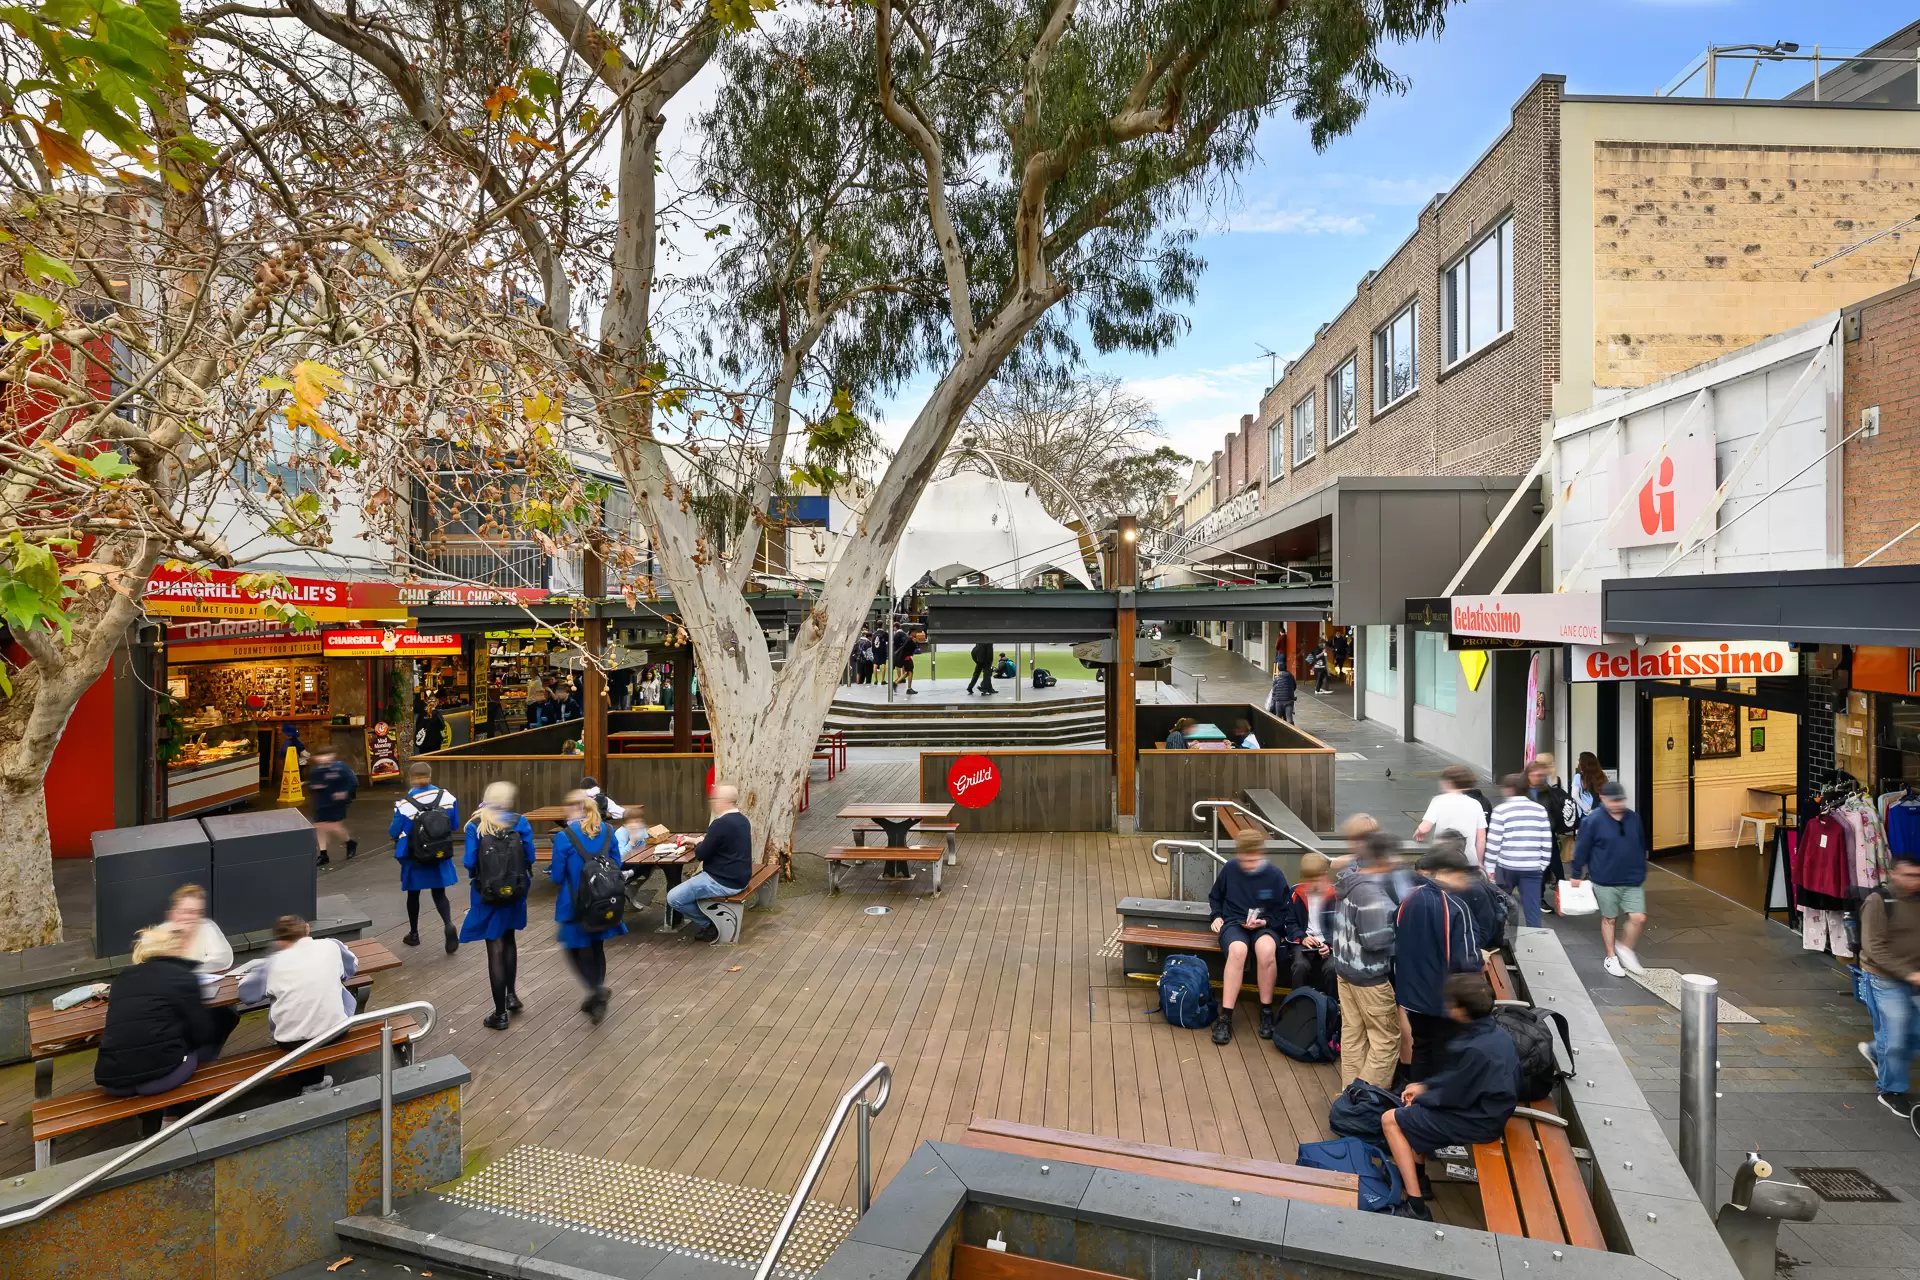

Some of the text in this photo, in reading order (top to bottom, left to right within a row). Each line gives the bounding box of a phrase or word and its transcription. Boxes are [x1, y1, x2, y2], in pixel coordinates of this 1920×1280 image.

[146, 580, 241, 598] CHARGRILL
[180, 604, 220, 614] GOURMET
[223, 606, 245, 615] FOOD
[248, 607, 258, 615] AT
[1454, 602, 1521, 634] Gelatissimo
[1560, 625, 1598, 639] LANE COVE
[328, 634, 454, 645] CHARGRILL CHARLIE'S
[1462, 638, 1504, 646] PROVEN
[233, 646, 267, 656] GOURMET
[270, 645, 287, 654] FOOD
[290, 644, 298, 653] AT
[300, 643, 311, 652] ITS
[1586, 643, 1784, 679] Gelatissimo
[953, 766, 993, 796] Grill'd
